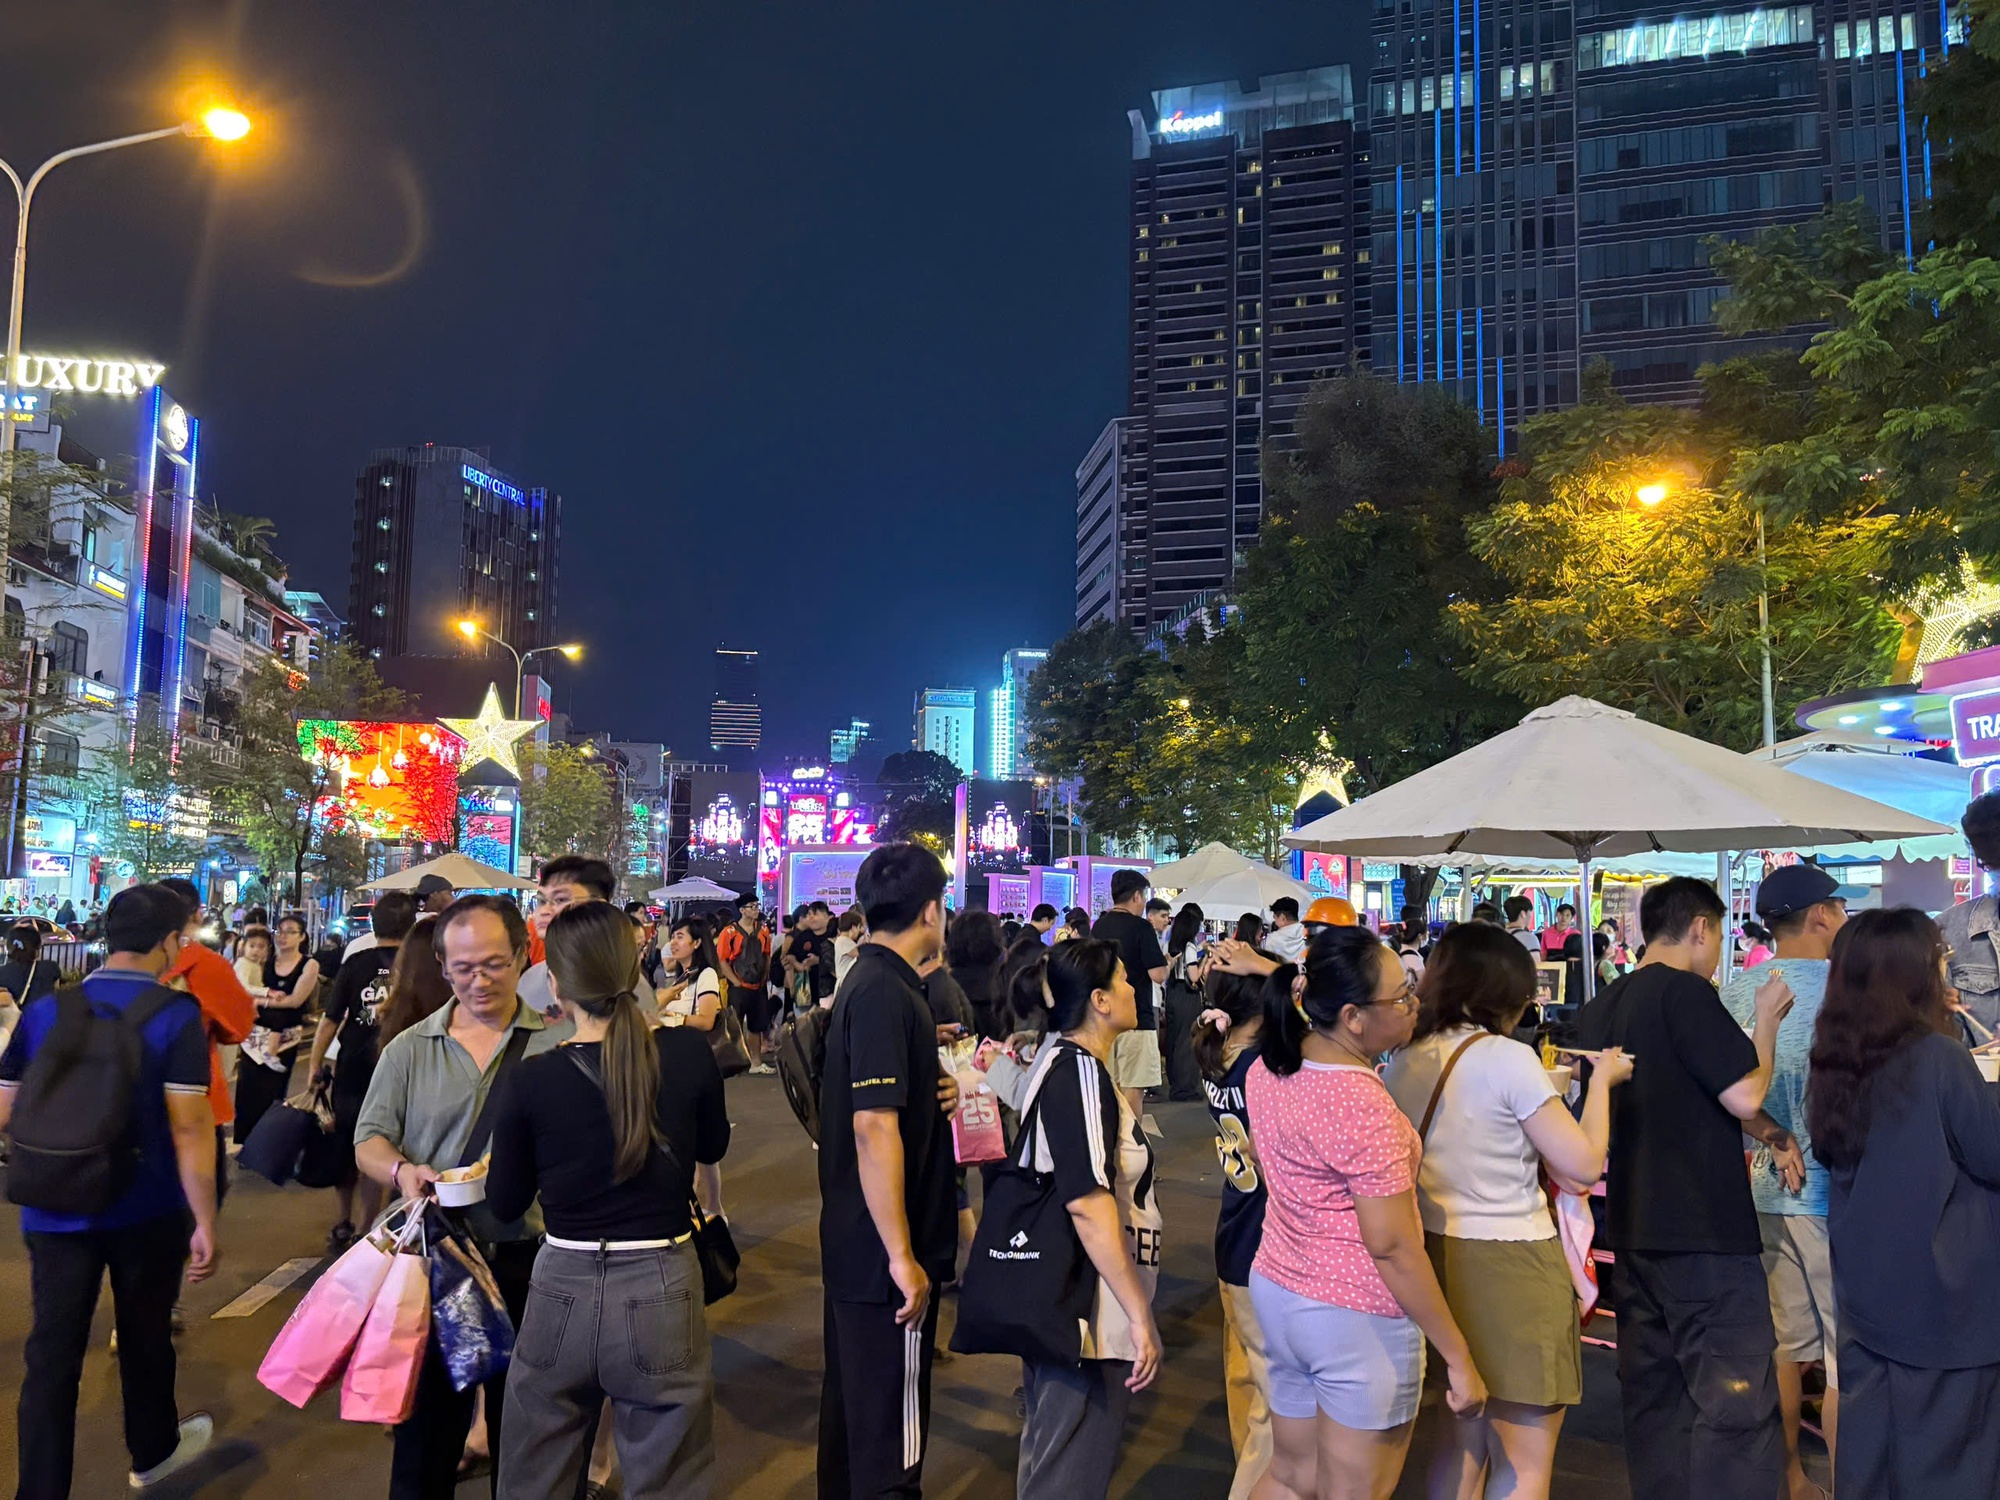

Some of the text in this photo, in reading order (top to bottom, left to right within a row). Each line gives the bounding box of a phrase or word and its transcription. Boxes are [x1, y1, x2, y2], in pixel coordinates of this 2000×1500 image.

[463, 464, 525, 506] LIBERTY CENTRAL
[960, 1096, 995, 1125] 25
